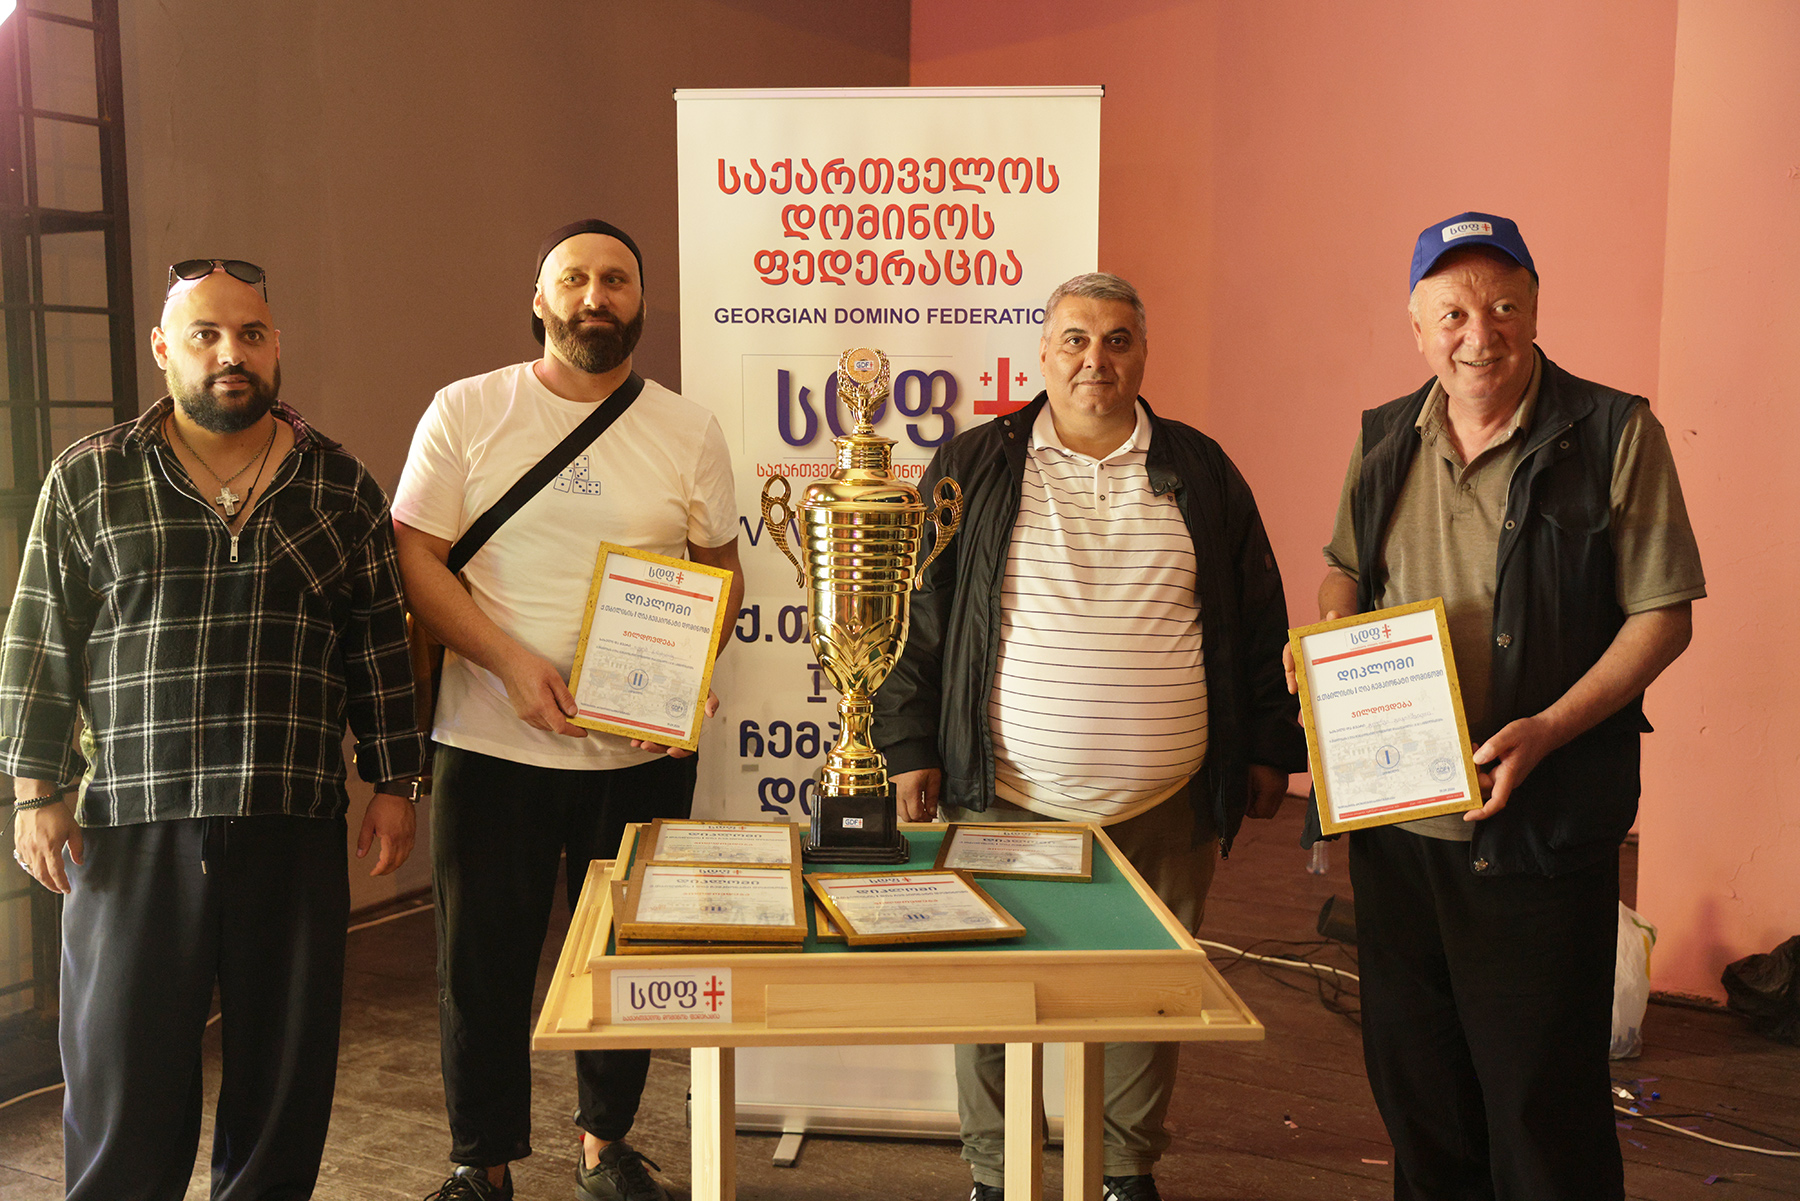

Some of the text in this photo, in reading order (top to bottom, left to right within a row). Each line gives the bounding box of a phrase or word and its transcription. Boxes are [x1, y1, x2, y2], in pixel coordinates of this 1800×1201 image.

[717, 156, 1060, 195] საქართველოს
[781, 203, 995, 240] დომინოს
[753, 249, 1023, 286] ფედერაცია
[714, 307, 1045, 325] GEORGIAN DOMINO FEDERATIO
[756, 463, 836, 478] საქართვე
[648, 566, 675, 582] სდფ
[625, 592, 692, 616] დიპლომი
[622, 630, 675, 647] ჯილდოვდება
[1350, 627, 1380, 645] სდფ
[1337, 656, 1415, 681] დიპლომი
[1351, 700, 1412, 718] ჯილდოვდება
[630, 980, 698, 1010] სდფ
